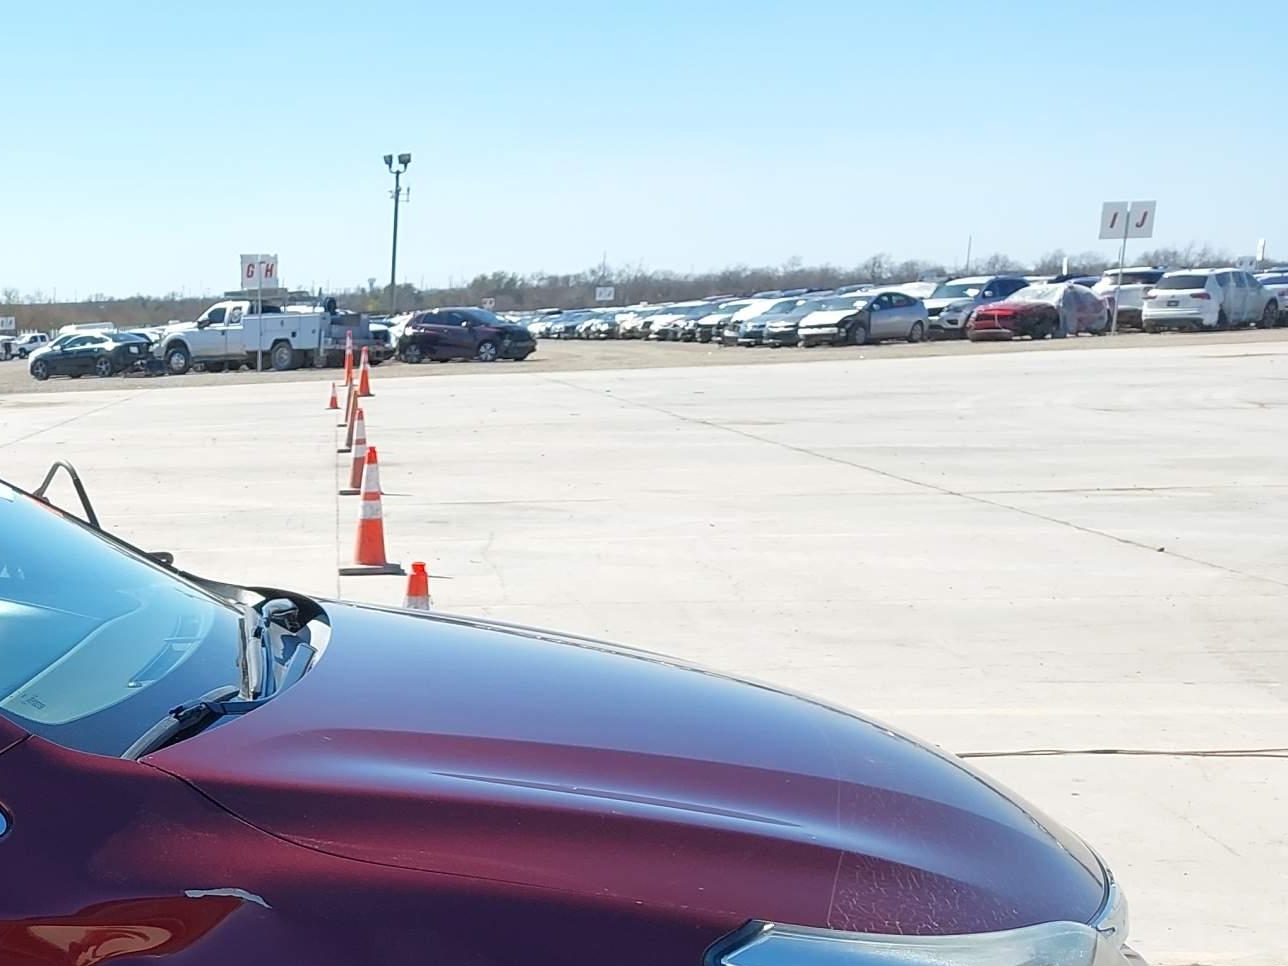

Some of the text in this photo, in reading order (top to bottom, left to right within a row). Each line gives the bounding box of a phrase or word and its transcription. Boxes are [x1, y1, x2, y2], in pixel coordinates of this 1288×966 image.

[1135, 210, 1148, 228] J
[246, 263, 274, 278] G H
